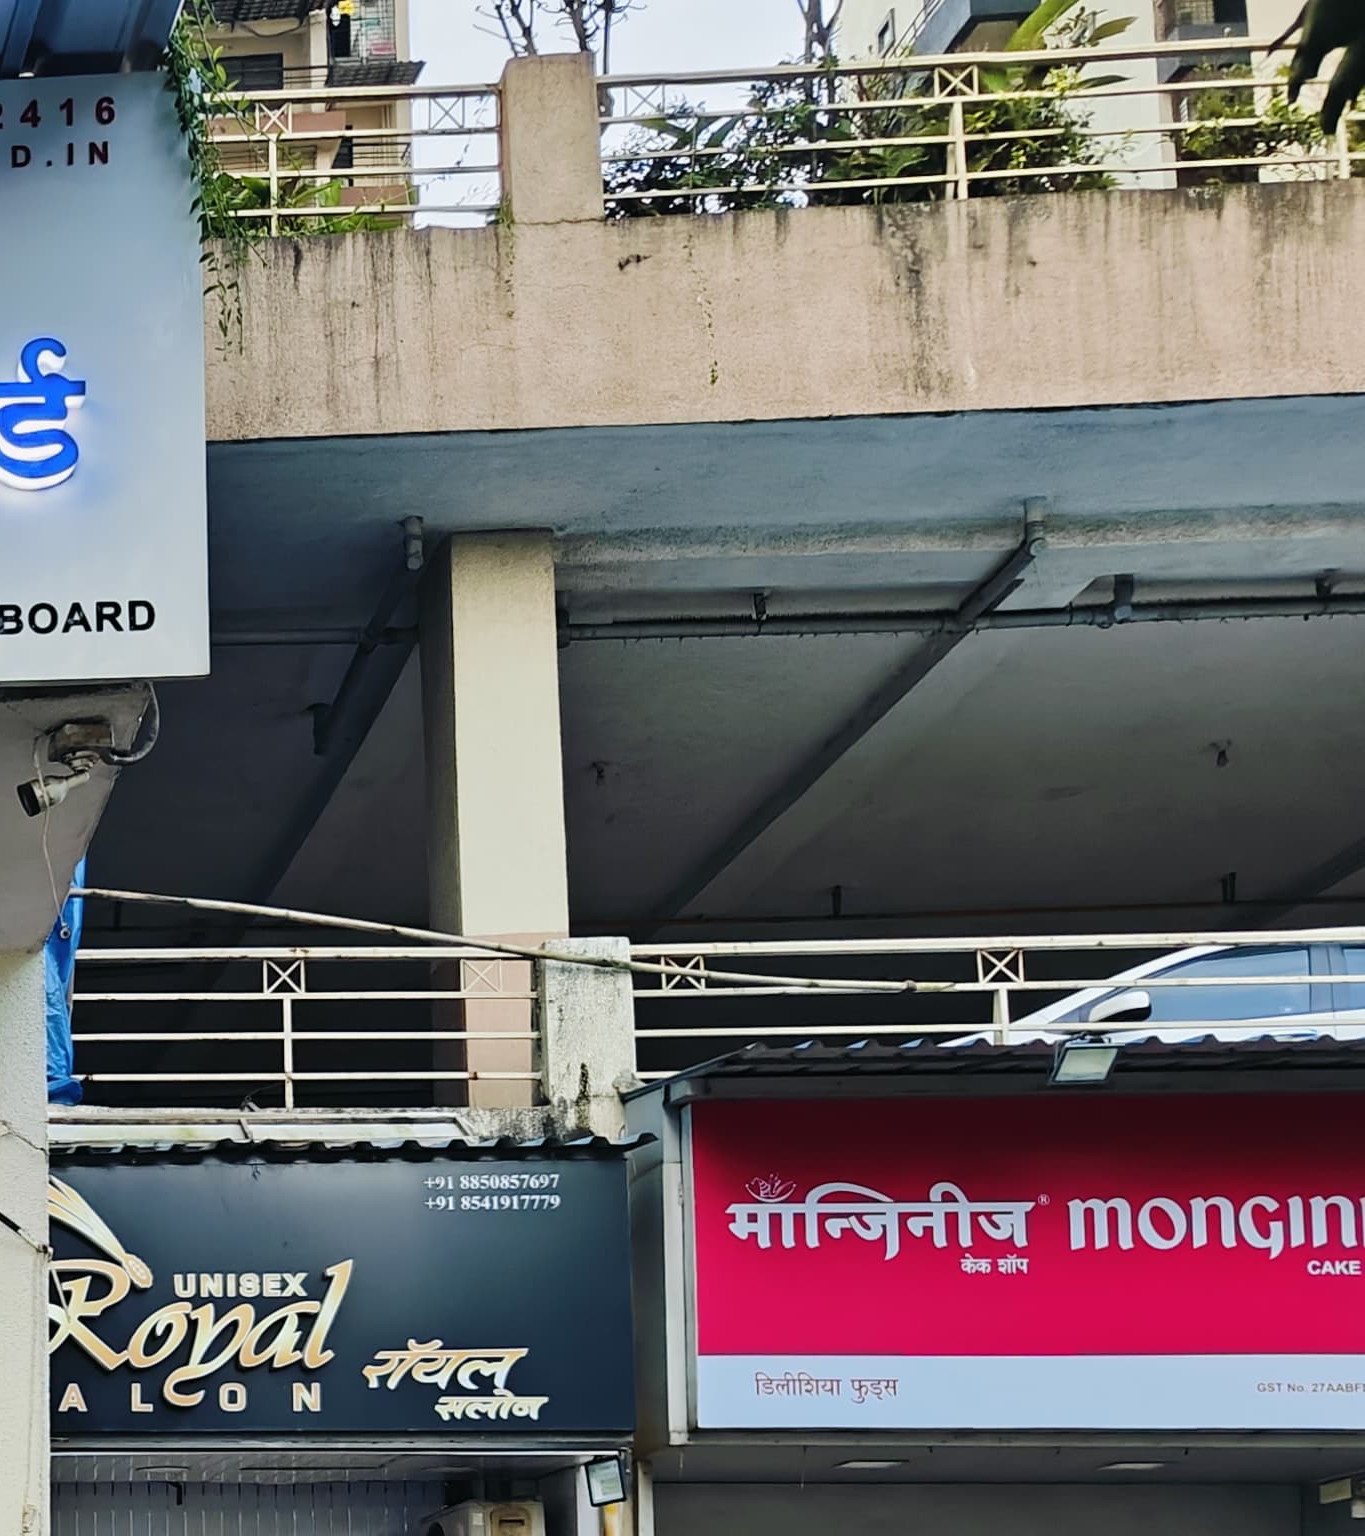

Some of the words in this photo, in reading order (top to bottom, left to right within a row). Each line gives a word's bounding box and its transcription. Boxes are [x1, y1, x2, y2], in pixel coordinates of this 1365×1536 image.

[424, 1175, 454, 1190] +91
[459, 1173, 560, 1190] 8850857697
[424, 1195, 455, 1210] +91
[460, 1194, 561, 1210] 8541917779
[1306, 1259, 1363, 1276] CAKE
[173, 1272, 308, 1298] UNISEX
[49, 1258, 353, 1407] Royal
[362, 1338, 529, 1391] रॉयल
[1256, 1382, 1283, 1393] GST
